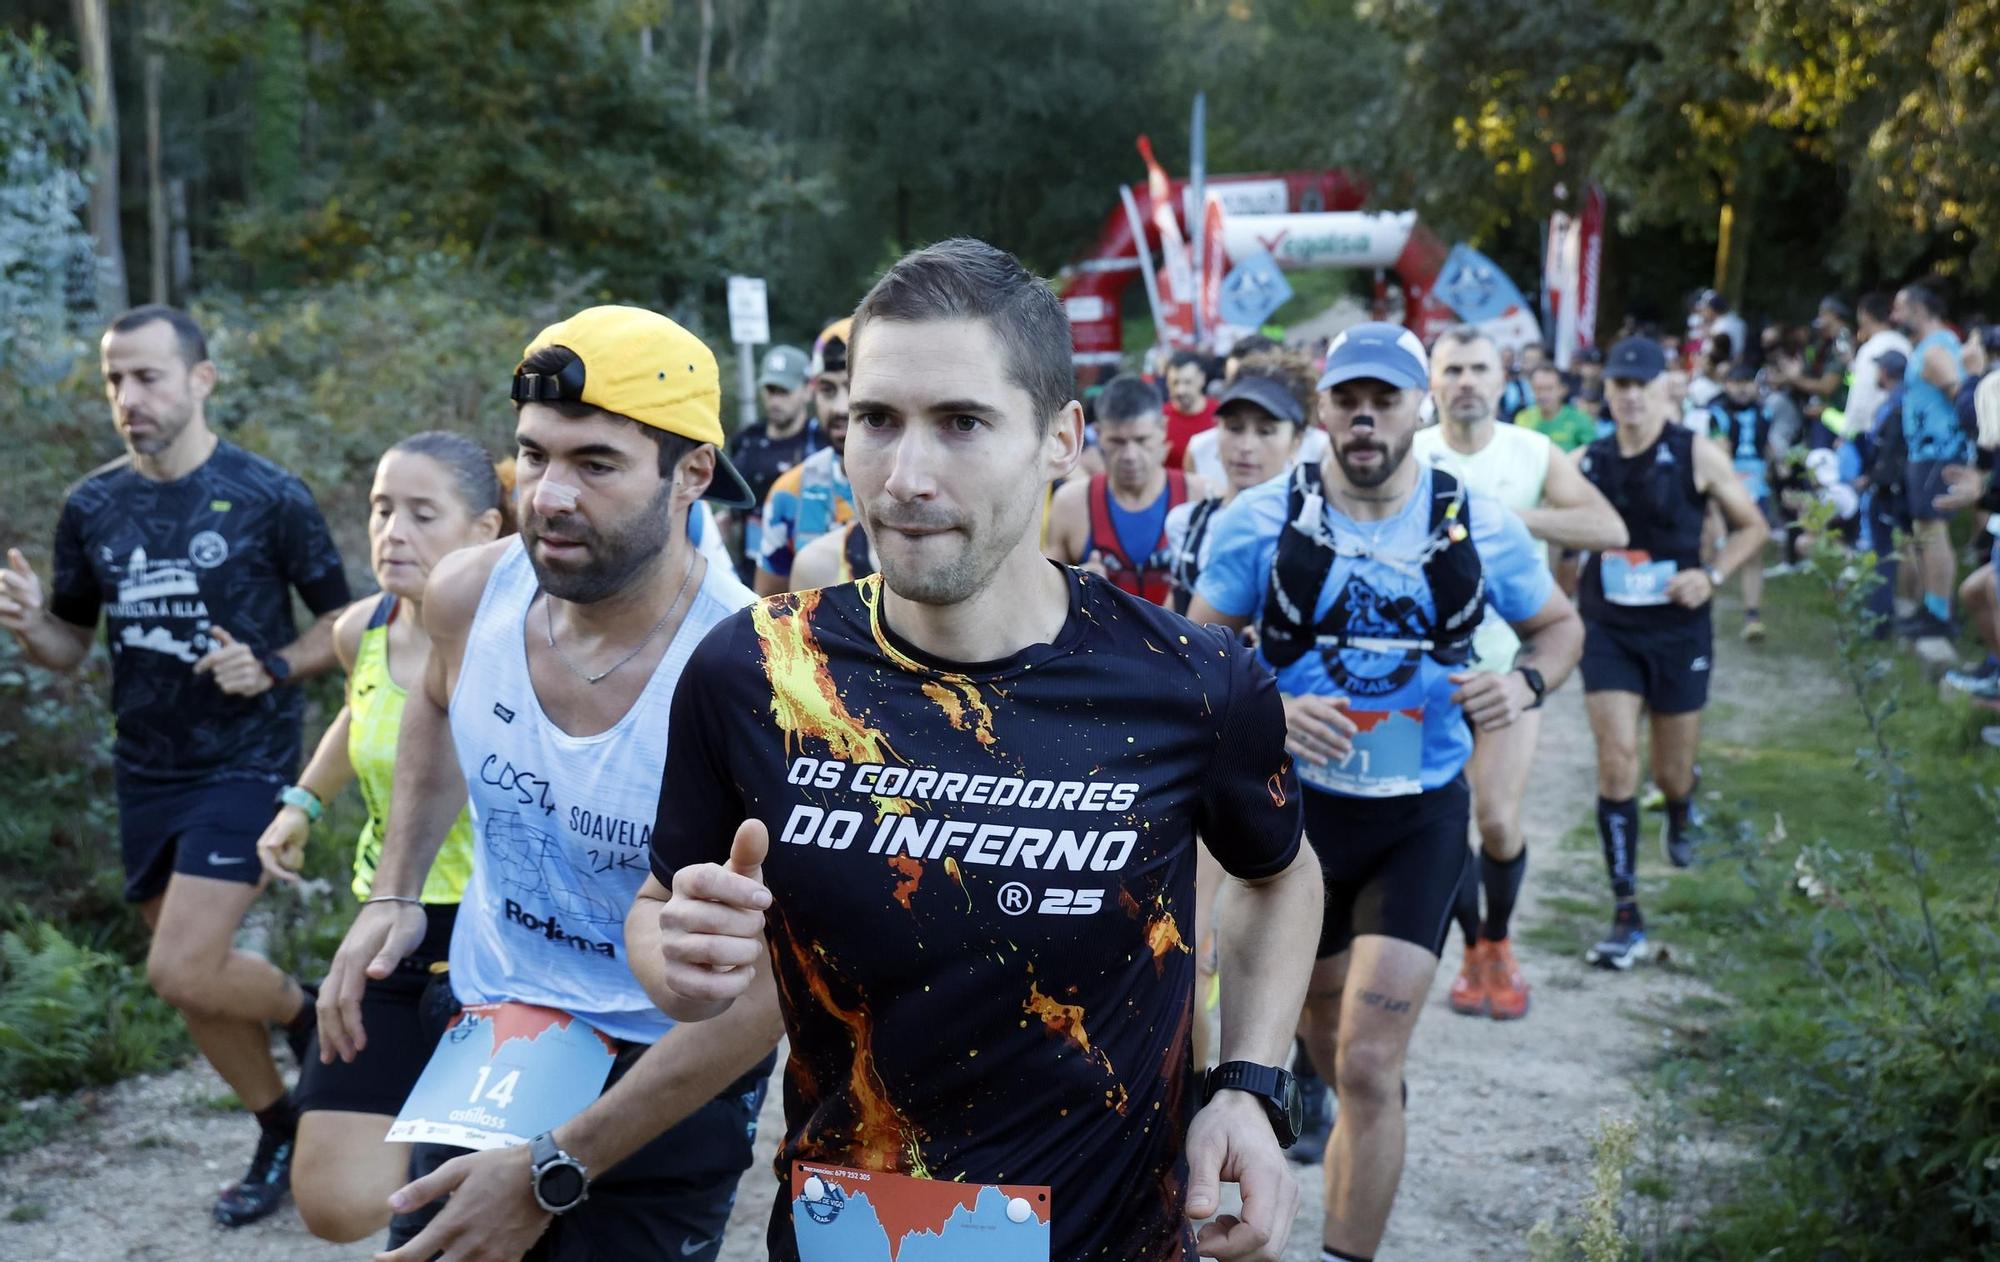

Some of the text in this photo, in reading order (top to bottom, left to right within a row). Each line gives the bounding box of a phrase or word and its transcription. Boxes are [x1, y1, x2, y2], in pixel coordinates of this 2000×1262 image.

[786, 757, 1140, 811] OS CORREDORES
[780, 804, 1139, 872] DO INFERNO
[1037, 888, 1106, 915] 25
[469, 1065, 521, 1109] 14
